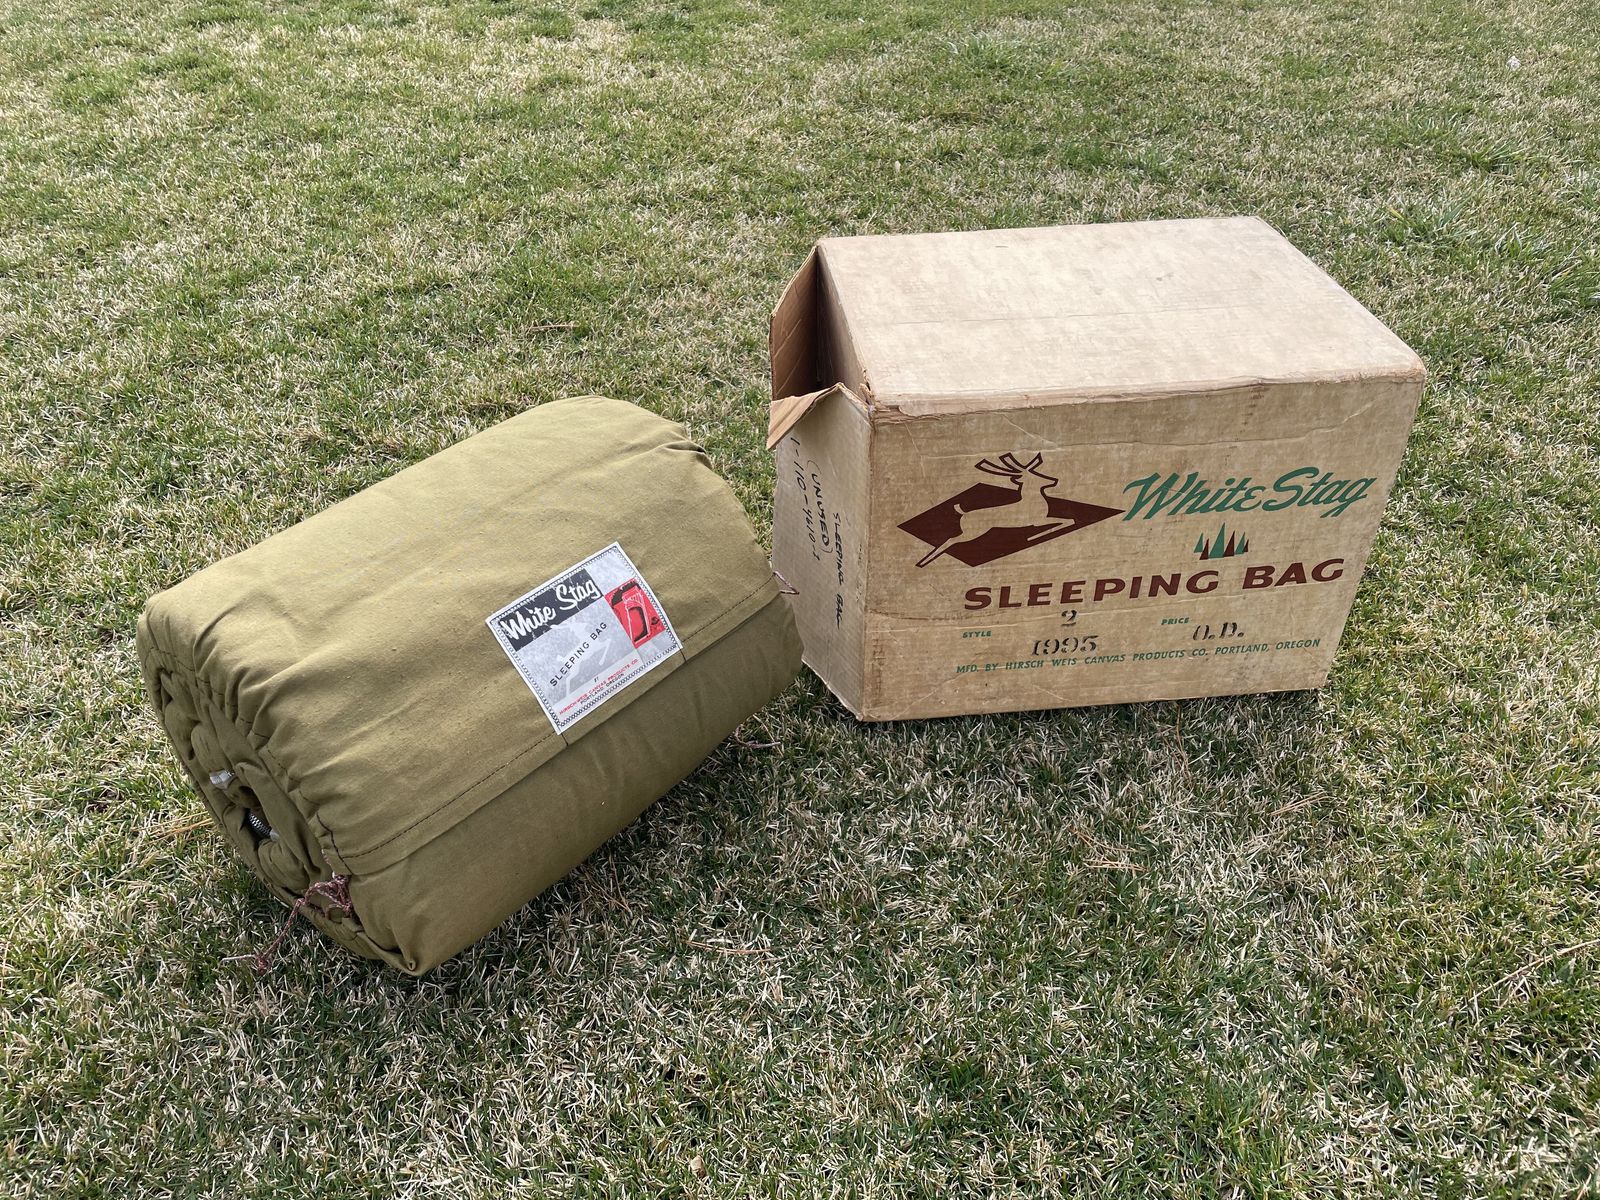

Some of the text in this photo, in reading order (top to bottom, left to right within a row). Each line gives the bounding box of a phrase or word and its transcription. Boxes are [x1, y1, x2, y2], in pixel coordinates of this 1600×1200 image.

[807, 460, 833, 554] (UNUSED)
[1122, 466, 1377, 521] White Stag
[833, 513, 844, 630] SLEEPING BAG
[964, 558, 1344, 611] SLEEPING BAG
[500, 579, 601, 640] White Stag
[1061, 609, 1078, 627] 2
[1161, 617, 1190, 625] PRICE
[962, 630, 992, 639] STYLE
[1032, 635, 1099, 656] 1995
[549, 621, 608, 687] SLEEPING BAG
[956, 639, 1321, 673] MFD. BY HIRSCH WEIS CANVAS PRODUCTS CO. PORTLAND, OREGON
[588, 680, 607, 694] CANVAS
[607, 664, 630, 681] PRODUCTS
[605, 673, 625, 688] OREGON
